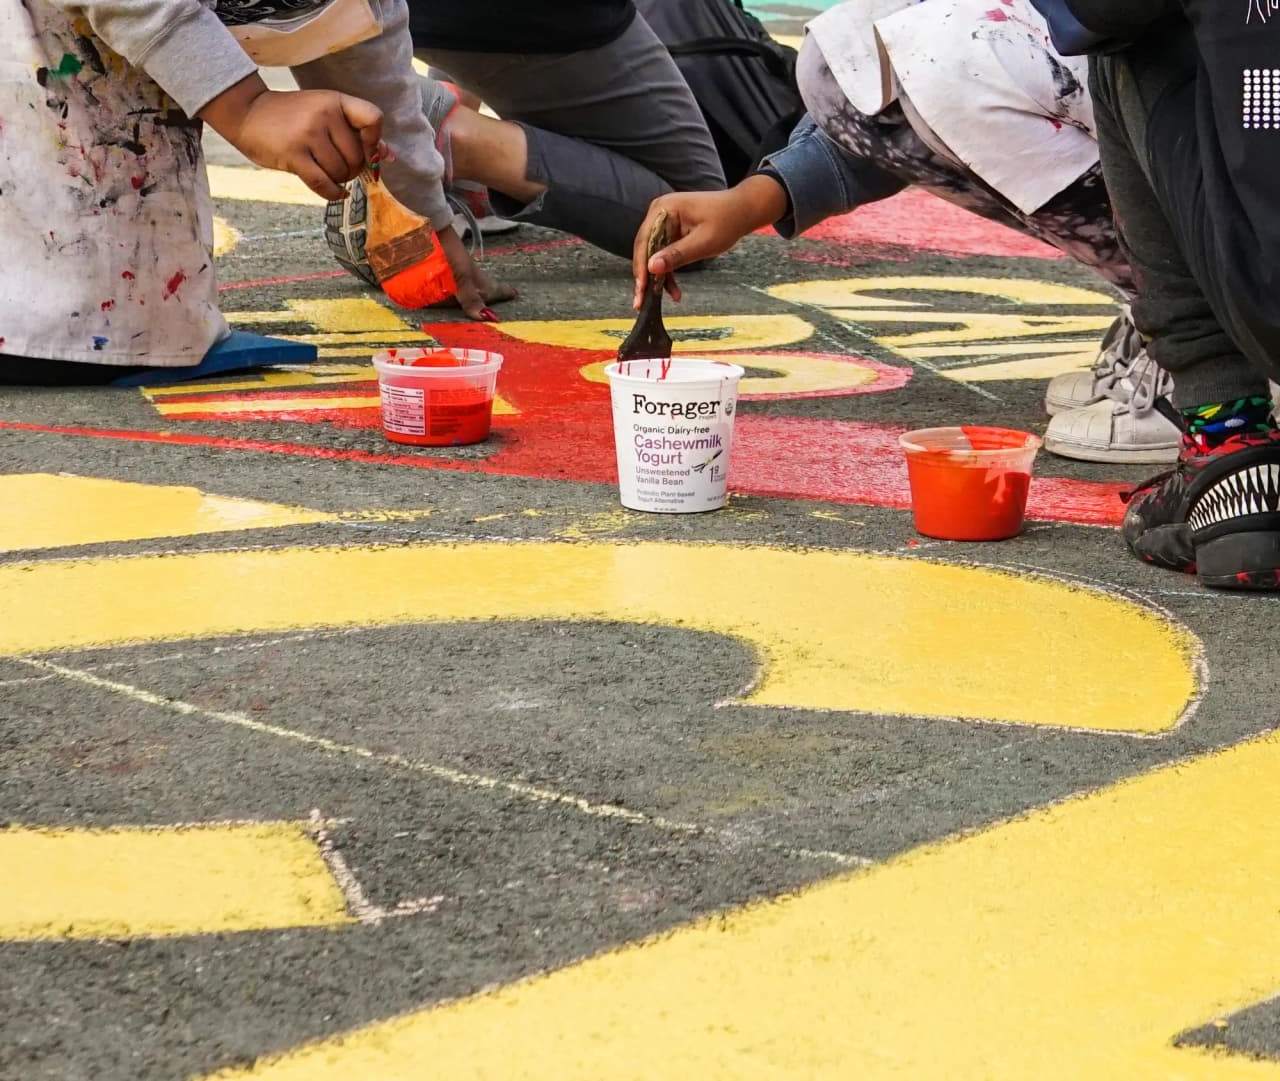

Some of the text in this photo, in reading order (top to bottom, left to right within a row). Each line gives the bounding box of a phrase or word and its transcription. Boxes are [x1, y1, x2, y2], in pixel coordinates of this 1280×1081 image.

[632, 393, 721, 419] Forager
[633, 424, 710, 435] Organic Dairy-free
[634, 434, 722, 450] Cashewmilk
[635, 448, 683, 466] Yogurt
[635, 466, 690, 477] Unsweetened
[636, 475, 684, 486] Vanilla Bean
